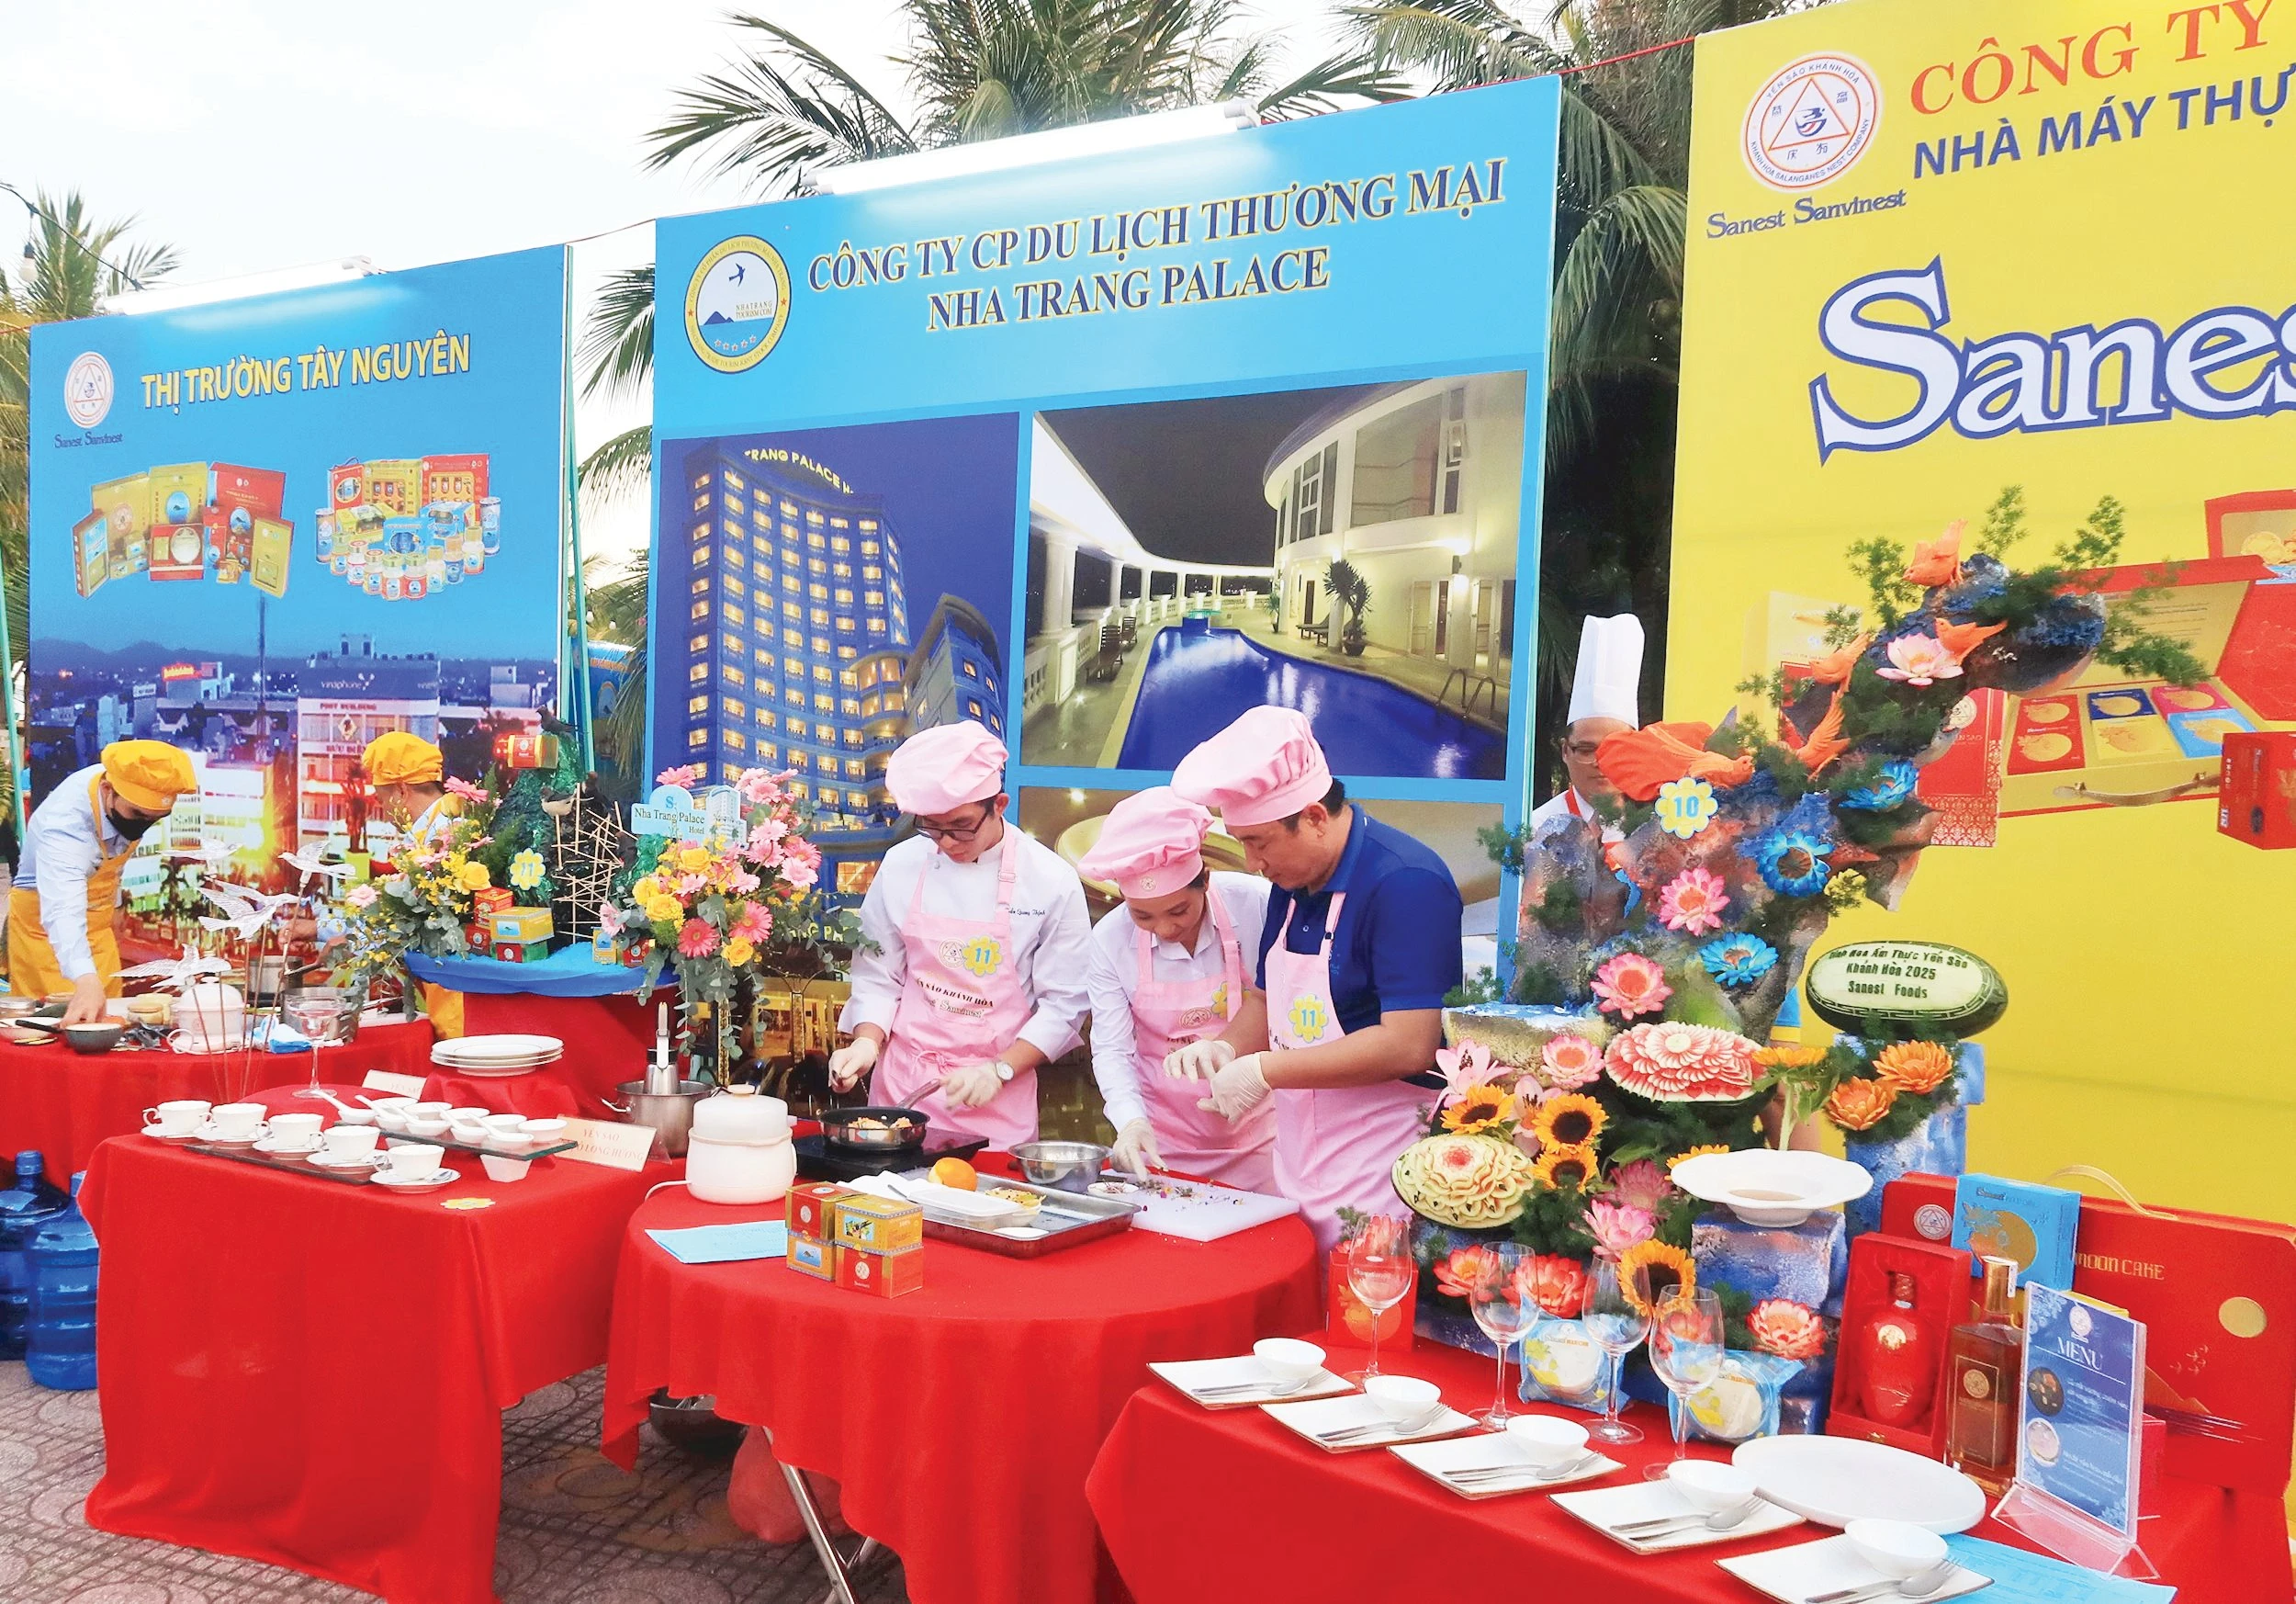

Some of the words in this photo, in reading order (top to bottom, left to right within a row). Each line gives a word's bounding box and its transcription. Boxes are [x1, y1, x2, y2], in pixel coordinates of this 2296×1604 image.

[1910, 22, 2140, 115] CÔNG
[2166, 0, 2273, 62] TY
[1914, 117, 2021, 179] NHÀ
[2038, 95, 2155, 156] MÁY
[1827, 155, 1847, 175] NEST
[809, 241, 908, 291] CÔNG
[917, 236, 964, 277] TY
[971, 230, 1019, 269] CP
[1027, 220, 1080, 265] DU
[1089, 206, 1191, 262] LỊCH
[1201, 174, 1396, 242] THƯƠNG
[1406, 158, 1507, 218] MẠI
[1706, 210, 1786, 239] Sanest
[1794, 189, 1908, 224] Sanvinest
[928, 288, 1007, 332] NHA
[1014, 267, 1151, 322] TRANG
[1161, 246, 1330, 305] PALACE
[1809, 254, 2296, 467] Sane
[141, 371, 181, 415] THỊ
[185, 355, 292, 403] TRƯỜNG
[297, 344, 346, 390] TÂY
[352, 329, 471, 385] NGUYÊN
[791, 451, 840, 489] PALACE
[635, 808, 651, 819] Nha
[654, 809, 678, 824] Trang
[680, 811, 705, 825] Palace
[1673, 796, 1699, 818] 10
[689, 826, 705, 835] Hotel
[974, 947, 991, 965] 11
[1848, 949, 1869, 959] Hoa
[1892, 949, 1919, 965] Thực
[1846, 959, 1878, 975] Khánh
[1881, 961, 1902, 976] Hòa
[1906, 964, 1937, 980] 2025
[943, 987, 974, 1003] KHÁNH
[974, 996, 995, 1009] HÒA
[1848, 980, 1885, 995] Sanest
[1895, 982, 1929, 999] Foods
[1301, 1009, 1316, 1027] 11
[2122, 1259, 2166, 1281] CAKE
[2057, 1337, 2103, 1371] MENU
